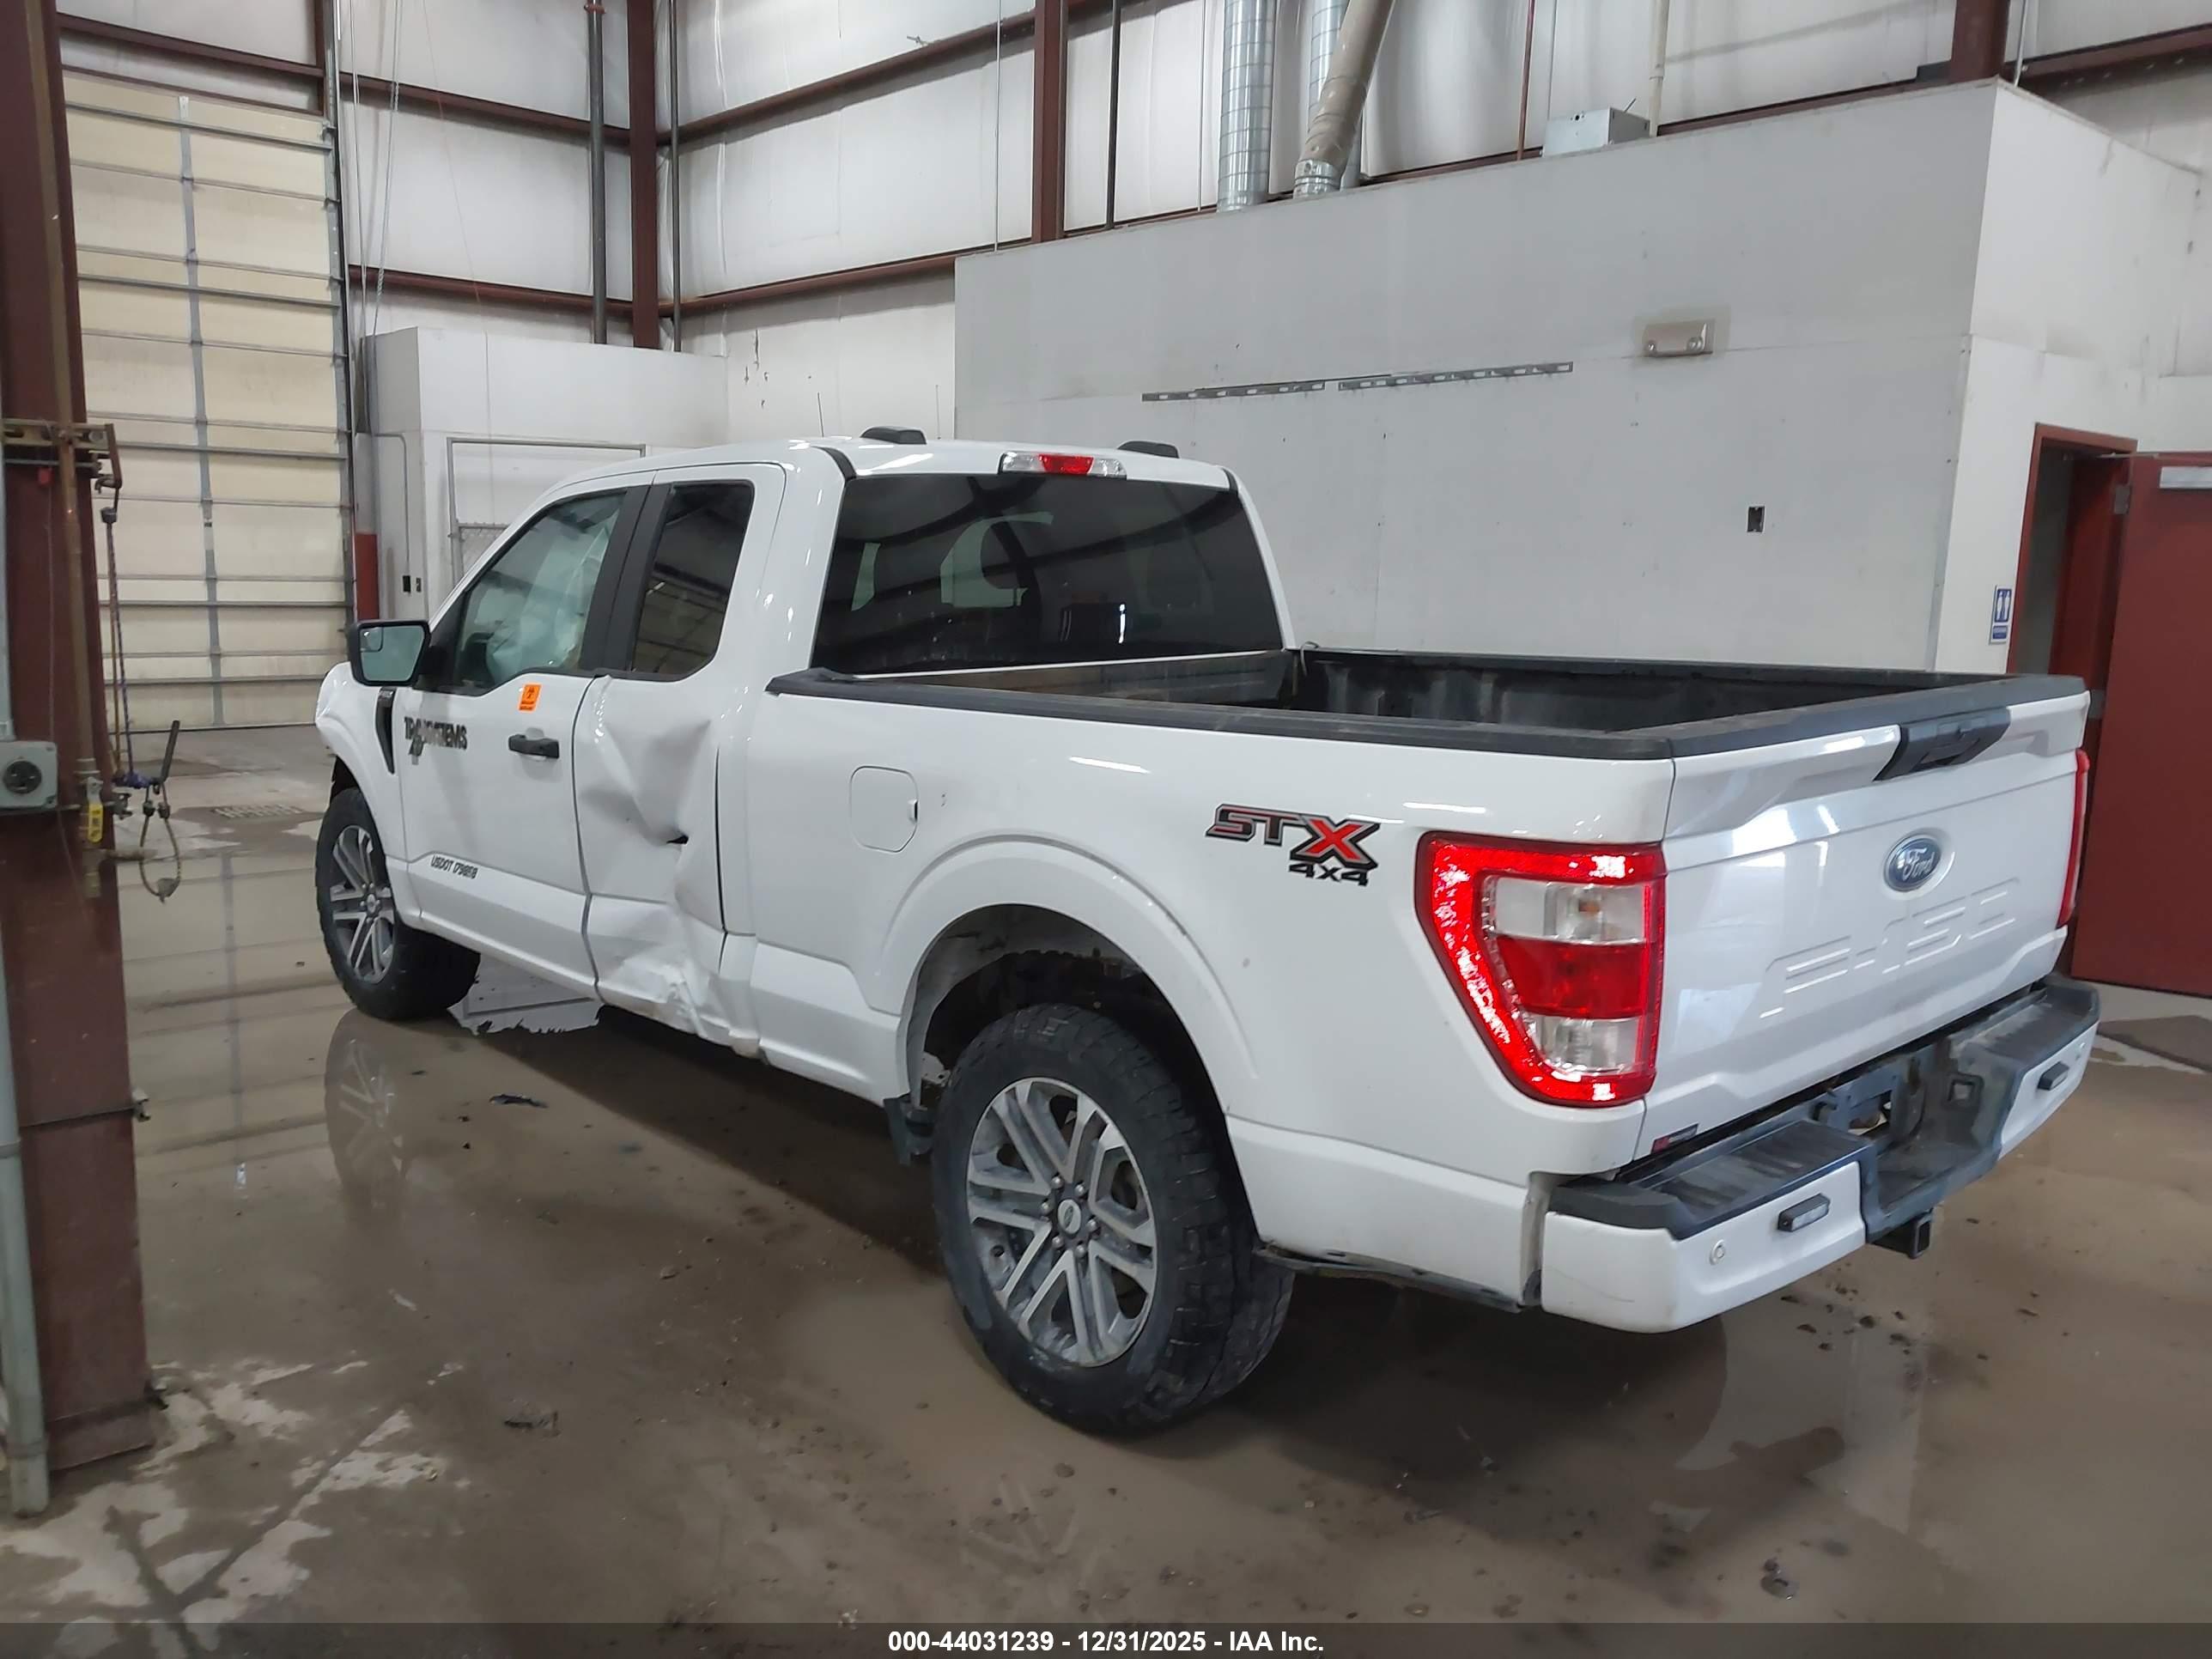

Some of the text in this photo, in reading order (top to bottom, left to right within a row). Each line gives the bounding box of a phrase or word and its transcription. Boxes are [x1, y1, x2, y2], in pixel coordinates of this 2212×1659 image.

[1206, 803, 1382, 871] STX
[1289, 862, 1369, 886] 4x4
[1902, 847, 1936, 881] Ford
